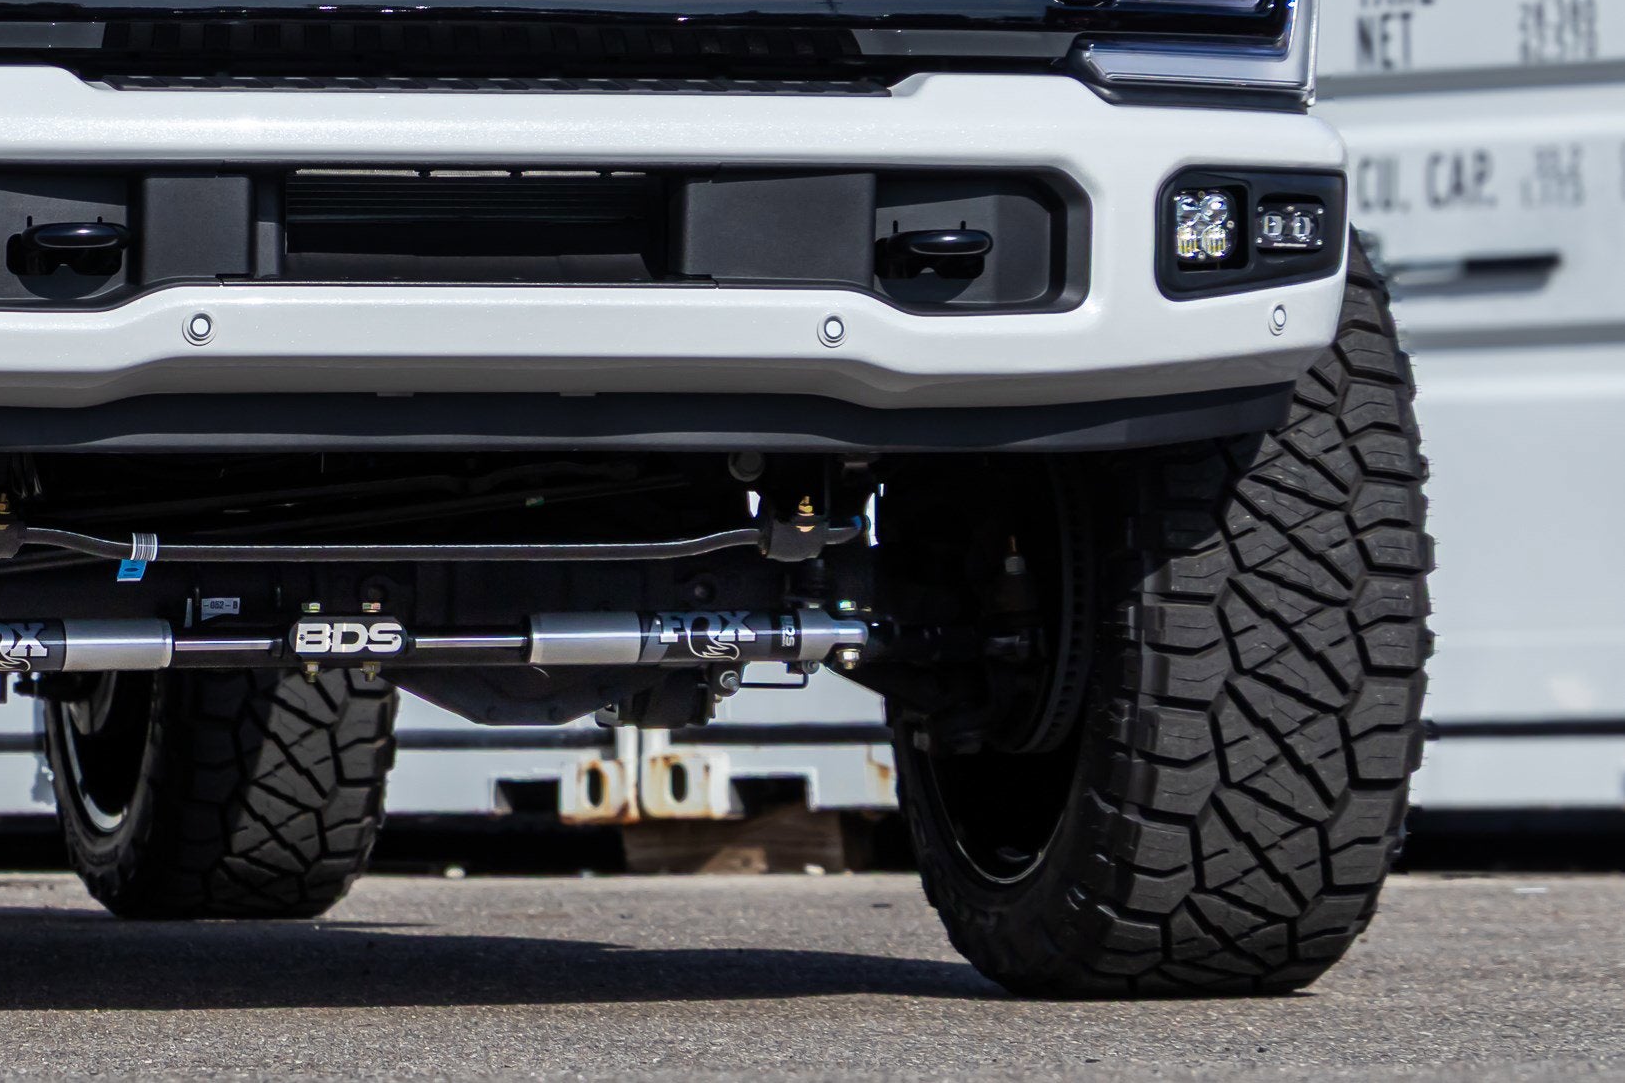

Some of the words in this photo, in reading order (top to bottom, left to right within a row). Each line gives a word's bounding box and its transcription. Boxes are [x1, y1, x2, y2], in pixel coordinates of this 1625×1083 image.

[1355, 11, 1412, 70] NET
[295, 622, 403, 653] BDS
[657, 610, 757, 660] FOX
